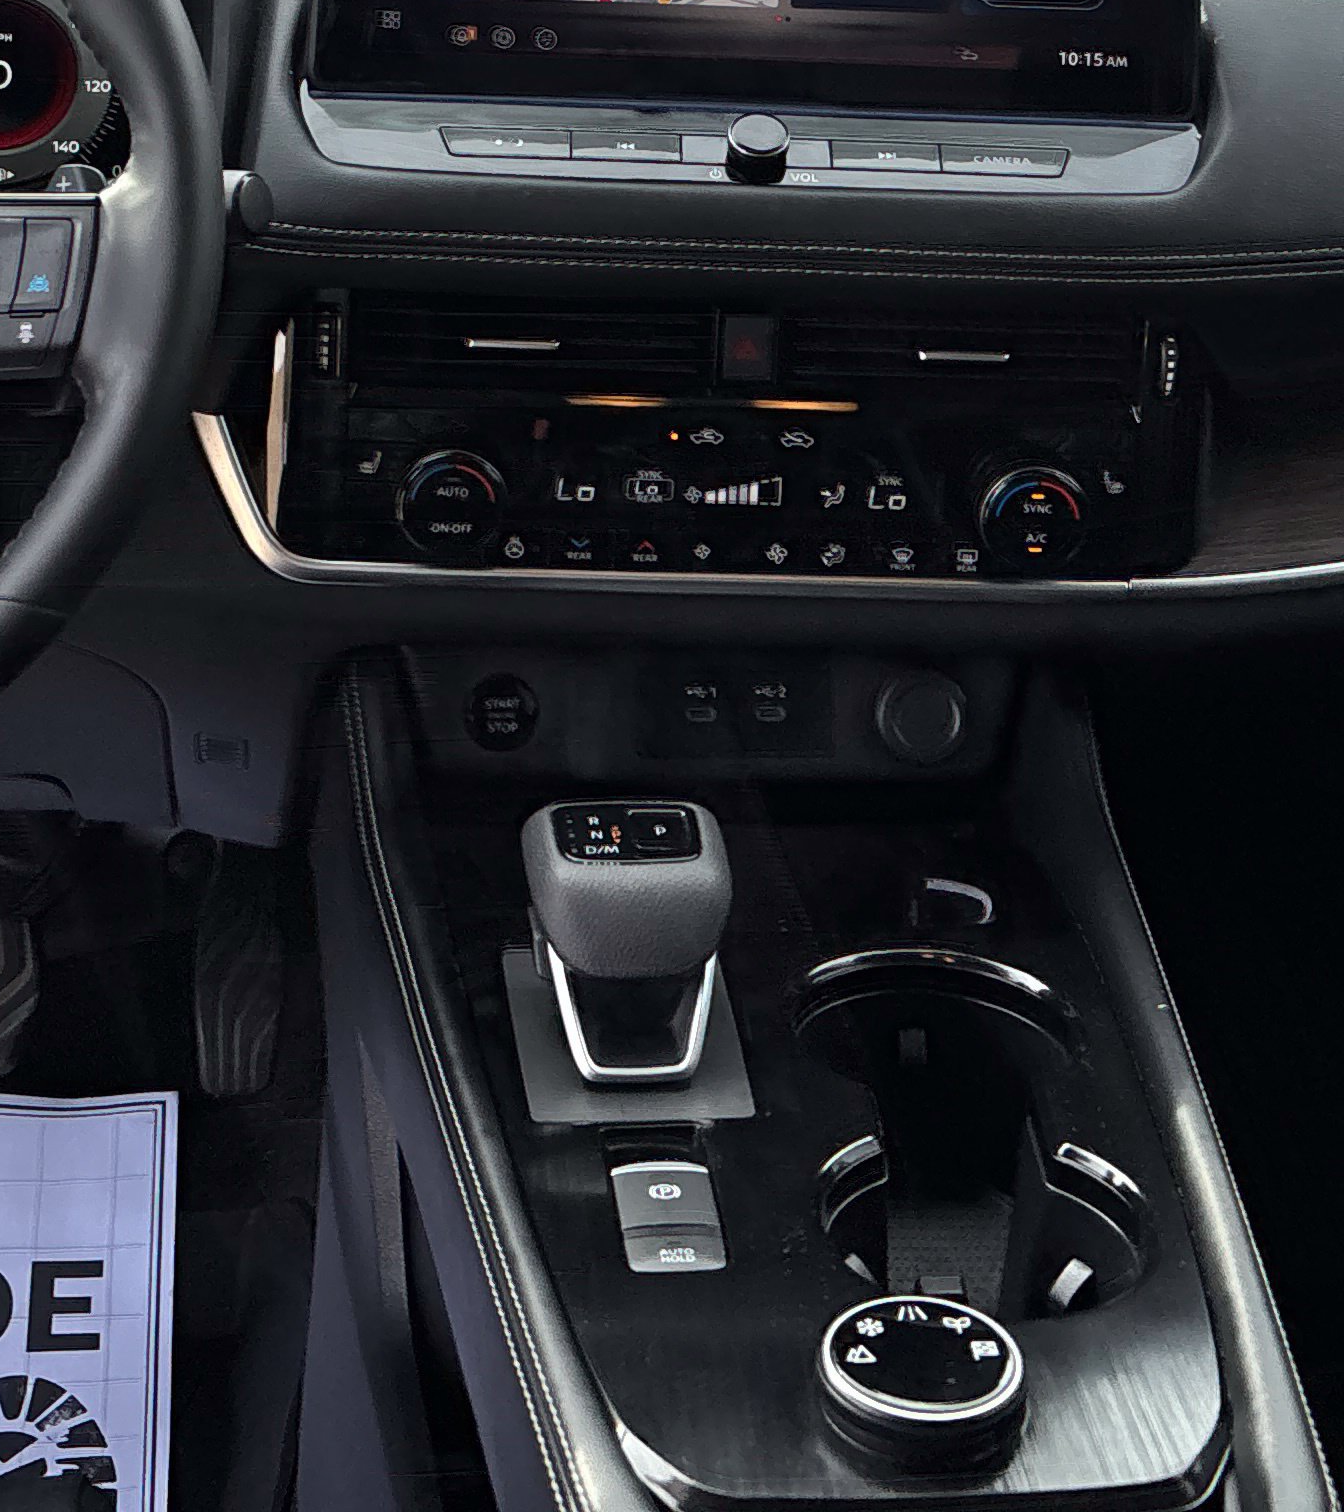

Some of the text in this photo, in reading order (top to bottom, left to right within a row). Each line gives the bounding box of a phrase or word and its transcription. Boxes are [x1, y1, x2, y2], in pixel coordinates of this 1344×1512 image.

[1059, 51, 1128, 68] 10:15 AM
[84, 80, 112, 93] 120
[52, 141, 79, 154] 140
[973, 155, 1031, 167] CAMERA
[790, 172, 819, 183] VOL
[436, 486, 470, 499] AUTO
[1023, 504, 1053, 515] SYNC
[1026, 533, 1047, 545] A/C
[567, 551, 592, 561] REAR
[633, 553, 659, 562] REAR
[487, 721, 518, 733] STOP
[587, 815, 600, 826] R
[590, 829, 604, 840] N
[654, 824, 667, 836] P
[584, 844, 620, 855] D/M
[659, 1247, 695, 1256] AUTO
[660, 1255, 696, 1263] HOLD
